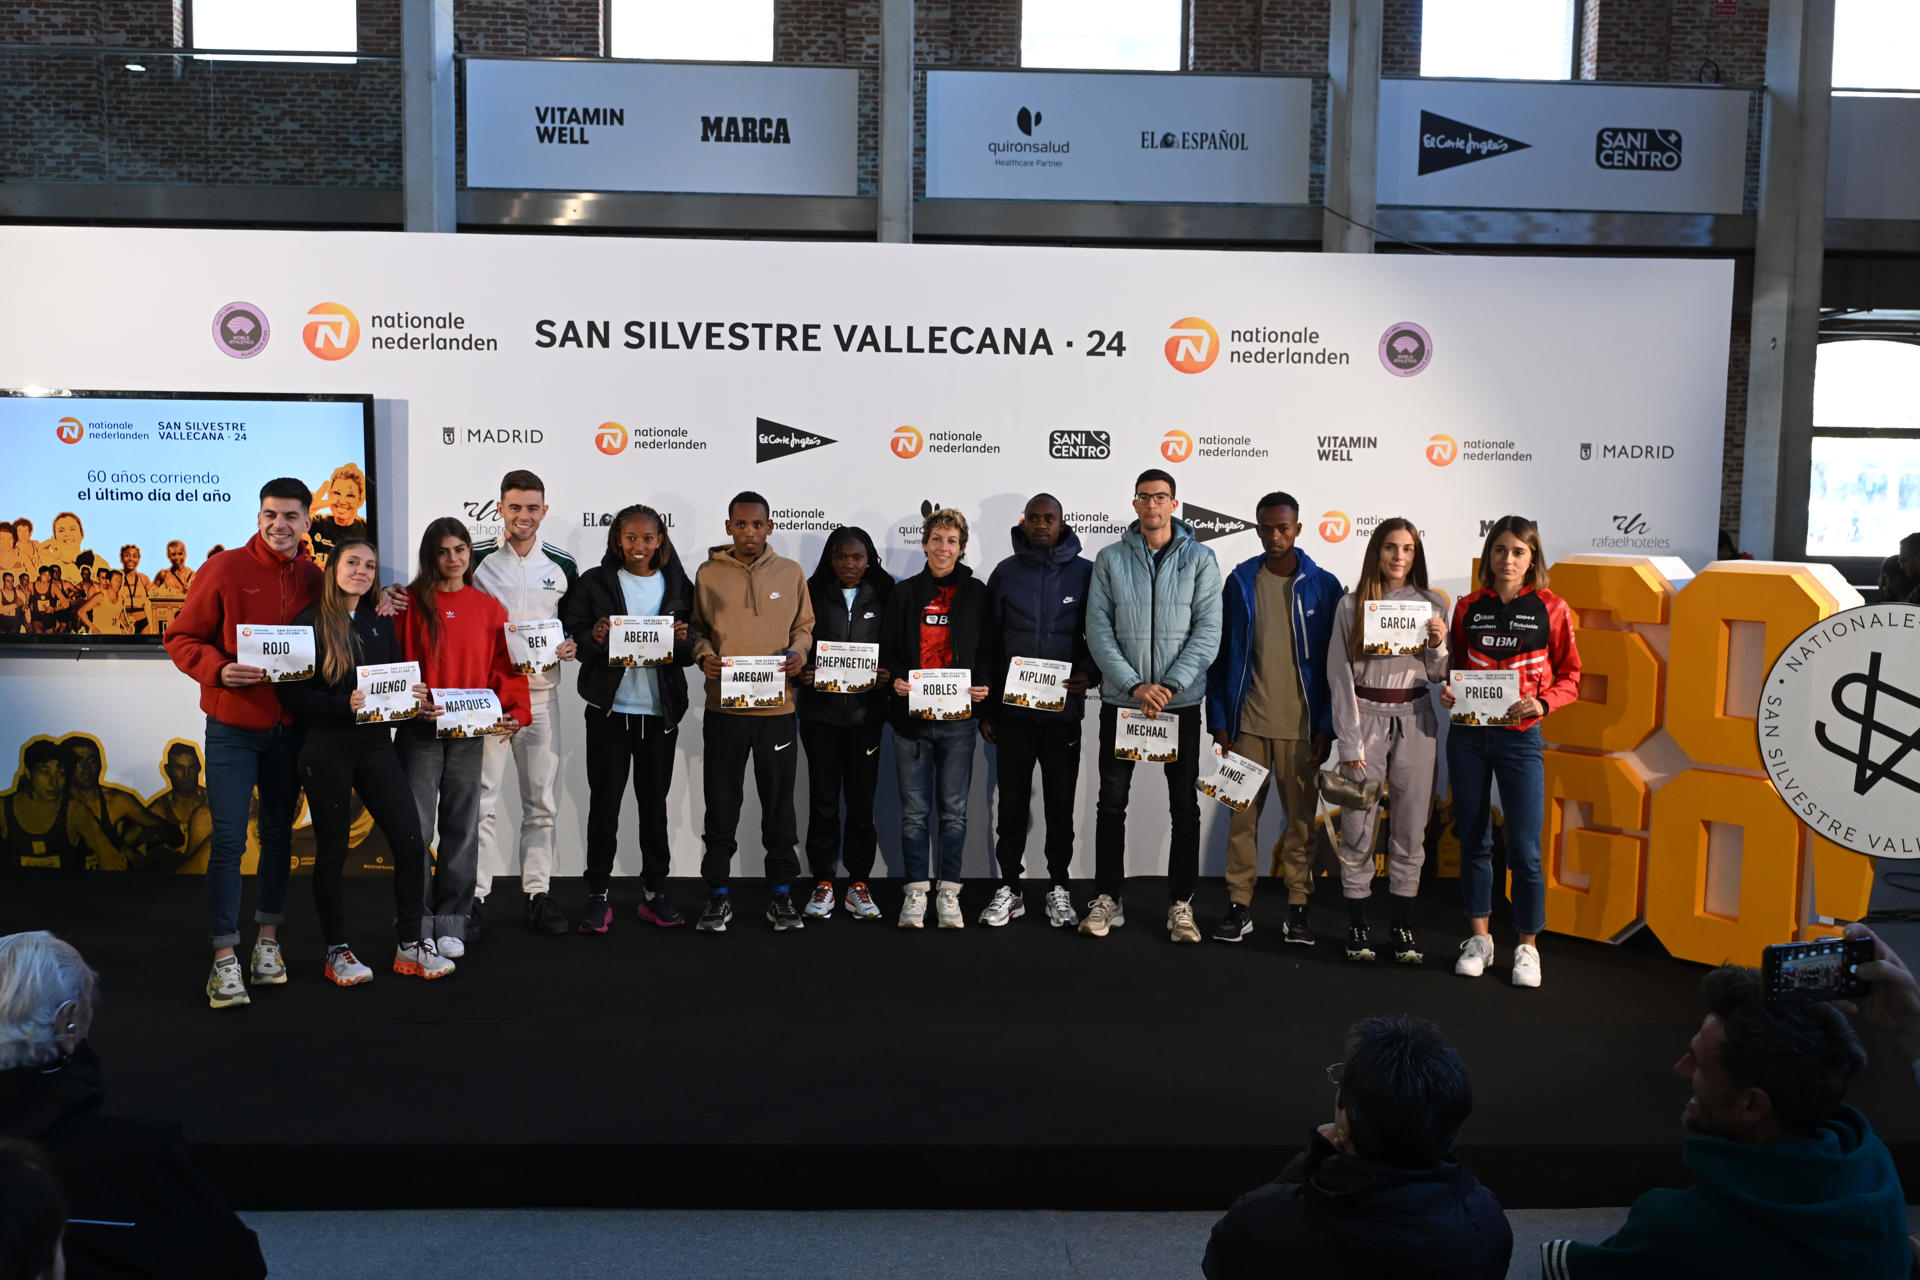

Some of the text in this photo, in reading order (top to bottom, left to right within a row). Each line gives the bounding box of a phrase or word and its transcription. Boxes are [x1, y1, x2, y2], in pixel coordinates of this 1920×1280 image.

[535, 107, 624, 126] VITAMIN
[536, 126, 589, 144] WELL
[700, 116, 791, 144] MARCA
[1141, 129, 1248, 151] EL ESPAÑOL
[1423, 133, 1508, 155] El Corte Inglés
[1602, 131, 1647, 149] SANI
[995, 159, 1063, 168] Healthcare Partner
[1600, 151, 1677, 168] CENTRO
[372, 312, 465, 329] nationale
[372, 333, 498, 351] nederlanden
[534, 319, 610, 348] SAN
[623, 320, 821, 352] SILVESTRE
[833, 324, 1054, 356] VALLECANA
[1085, 330, 1126, 357] 24
[1231, 327, 1319, 344] nationale
[1231, 347, 1349, 365] nederlanden
[88, 421, 133, 430] nationale
[158, 421, 246, 431] SAN SILVESTRE
[89, 431, 149, 440] nederlanden
[159, 431, 224, 441] VALLECANA
[234, 432, 247, 441] 24
[467, 429, 544, 444] MADRID
[634, 427, 688, 438] nationale
[929, 431, 982, 442] nationale
[1053, 432, 1086, 444] SANI
[634, 439, 707, 450] nederlanden
[759, 432, 821, 448] El Corte Inglés
[1199, 435, 1251, 446] nationale
[1317, 436, 1377, 449] VITAMIN
[1463, 438, 1515, 450] nationale
[929, 443, 1000, 454] nederlanden
[1052, 445, 1108, 458] CENTRO
[1199, 447, 1268, 458] nederlanden
[1603, 445, 1674, 460] MADRID
[1318, 450, 1353, 462] WELL
[1463, 450, 1532, 462] nederlanden
[87, 470, 220, 484] 60 años corriendo
[78, 488, 231, 502] el último día del año
[583, 512, 598, 527] EL
[772, 508, 825, 518] nationale
[1064, 512, 1109, 522] ationale
[1193, 519, 1214, 529] Corte
[1214, 517, 1245, 532] Inglés
[1357, 515, 1384, 525] natio
[1071, 523, 1127, 534] derlanden
[1592, 536, 1670, 548] rafaelhoteles
[1380, 617, 1416, 629] GARCIA
[528, 636, 547, 648] BEN
[624, 631, 659, 642] ABERTA
[1786, 612, 1920, 672] NATIONALE
[263, 642, 289, 655] ROJO
[816, 656, 876, 669] CHEPNGETICH
[733, 672, 773, 682] AREGAWI
[1020, 670, 1056, 686] KIPLIMO
[371, 680, 406, 694] LUENGO
[923, 684, 957, 695] ROBLES
[1465, 687, 1503, 699] PRIEGO
[445, 699, 491, 712] MARQUES
[1764, 695, 1782, 737] SAN
[1127, 724, 1168, 738] MECHAAL
[1219, 764, 1246, 784] KINDE
[1769, 748, 1857, 842] SILVESTRE
